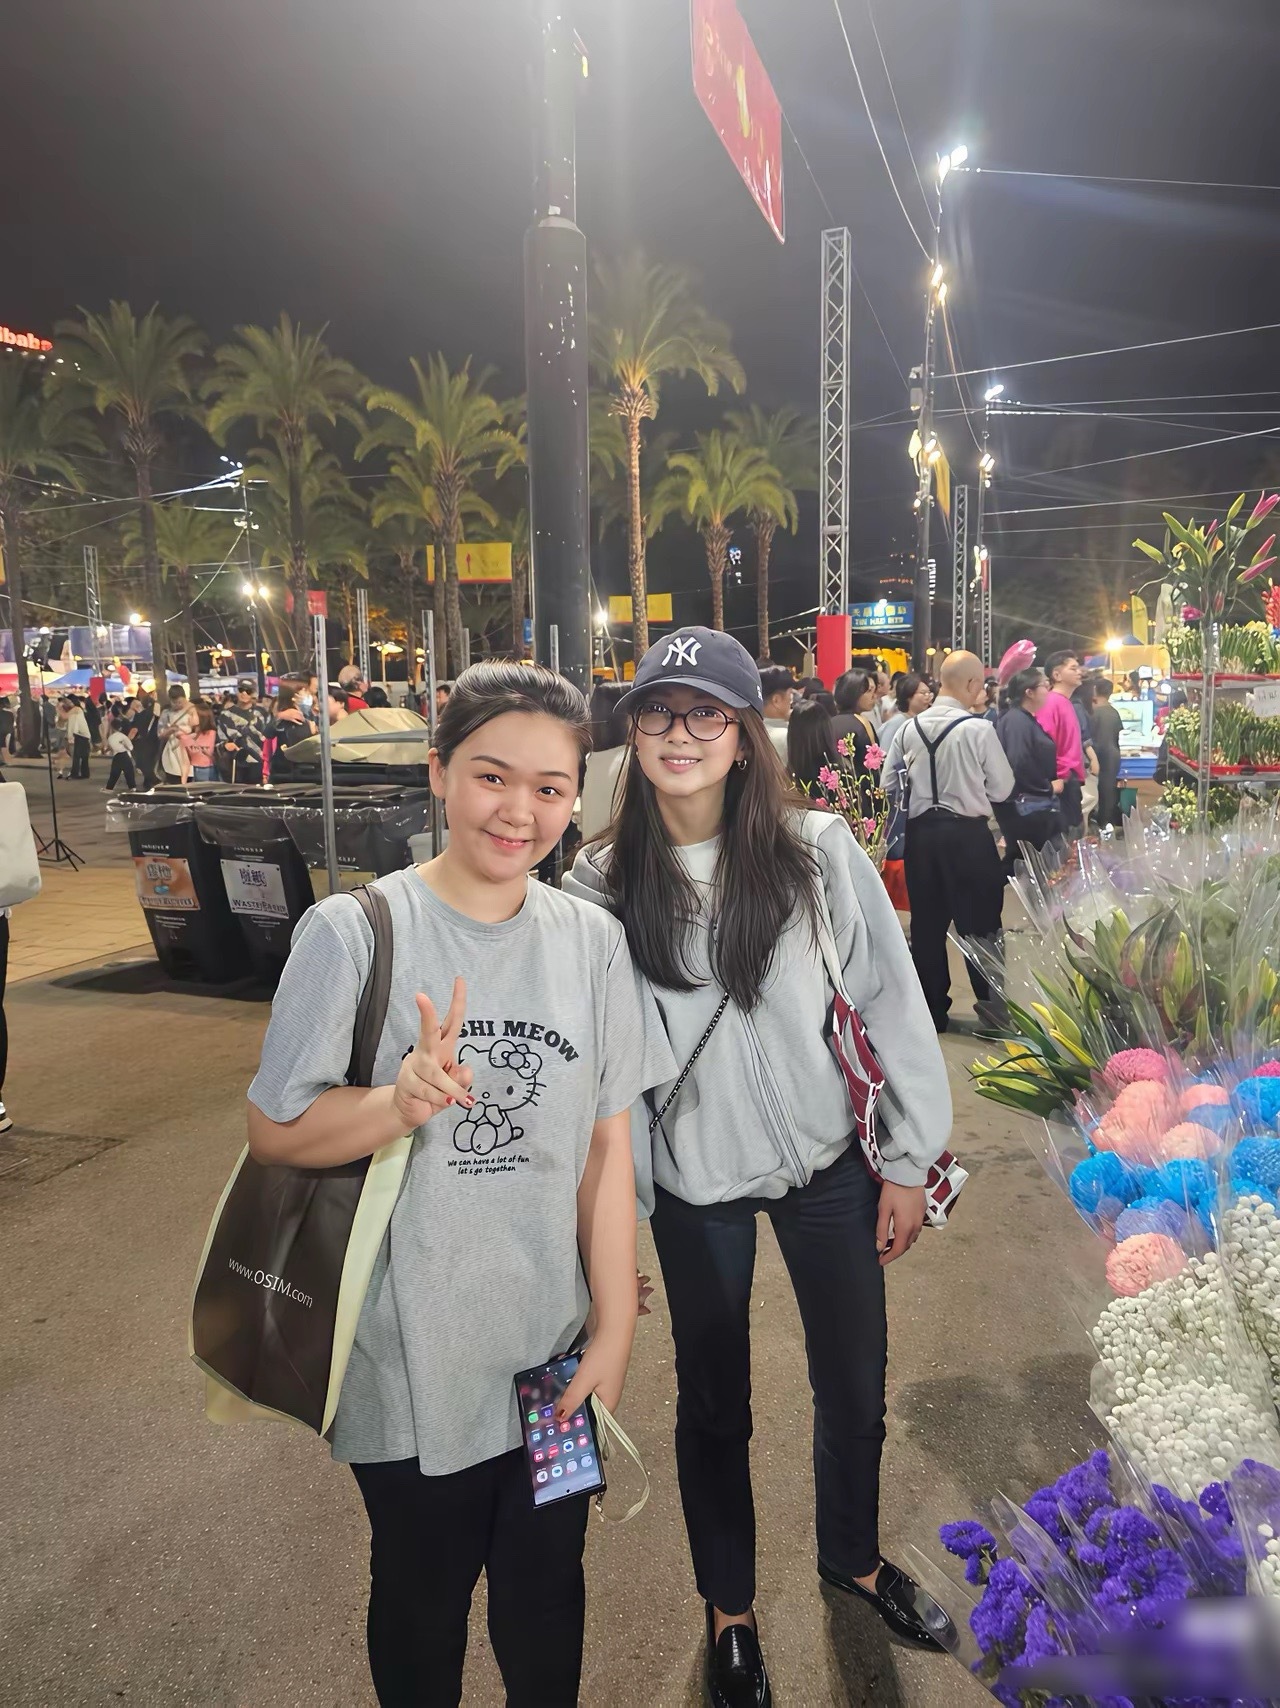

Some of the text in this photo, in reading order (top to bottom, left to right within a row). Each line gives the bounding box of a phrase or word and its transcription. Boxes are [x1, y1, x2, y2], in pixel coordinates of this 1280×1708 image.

[661, 636, 702, 667] NY
[502, 1020, 580, 1063] MEOW
[447, 1160, 458, 1168] We
[458, 1159, 472, 1167] can
[473, 1157, 490, 1166] have
[496, 1155, 507, 1164] lot
[508, 1154, 517, 1163] of
[517, 1154, 530, 1163] fun
[228, 1258, 313, 1309] www.OSIM.com
